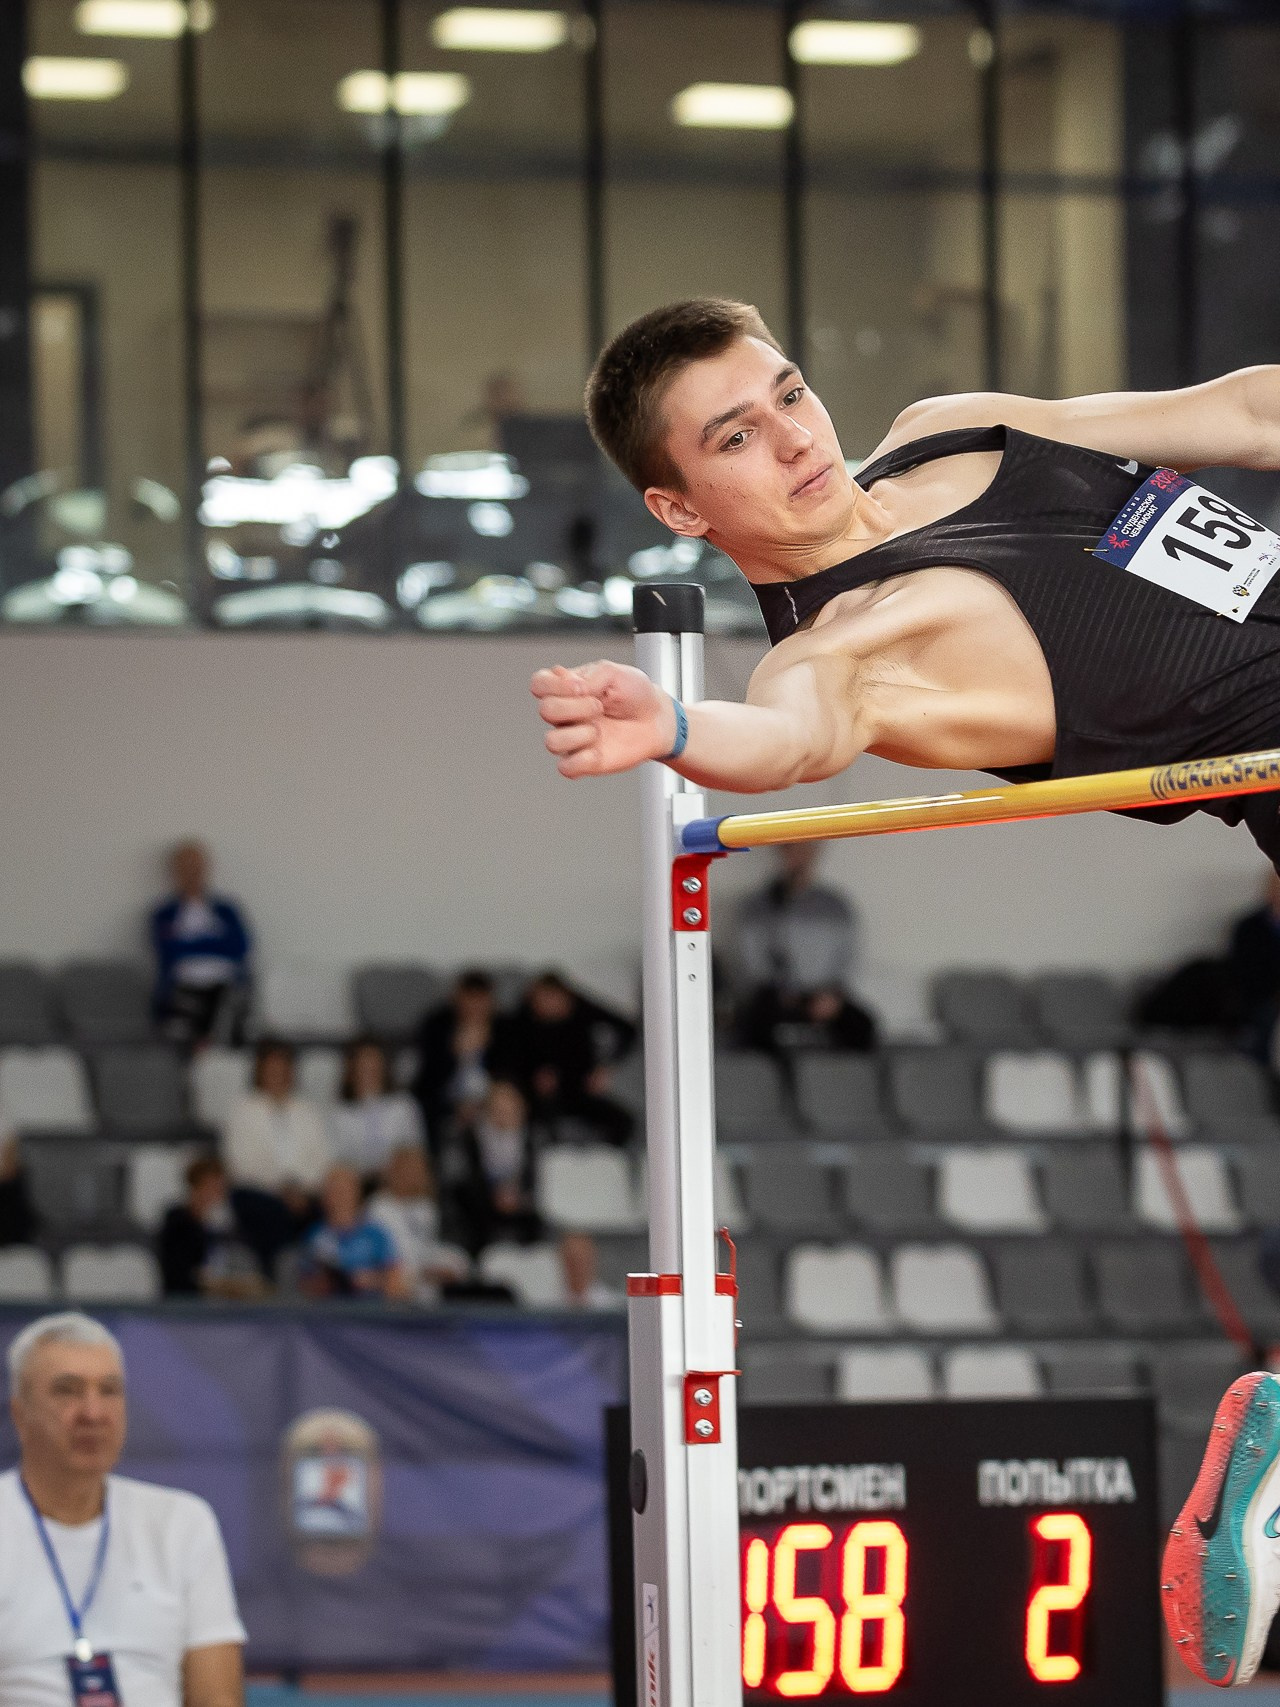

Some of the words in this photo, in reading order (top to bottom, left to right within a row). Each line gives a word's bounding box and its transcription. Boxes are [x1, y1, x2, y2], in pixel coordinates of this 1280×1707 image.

[1121, 493, 1157, 535] СТУДЕНЧЕСКИЙ
[1129, 504, 1158, 537] ЧЕМПИОНАТ
[1162, 495, 1266, 572] 158
[737, 1464, 907, 1515] ПОРТСМЕН
[977, 1458, 1135, 1508] ПОПЫТКА
[743, 1520, 909, 1697] 158
[1025, 1513, 1092, 1682] 2
